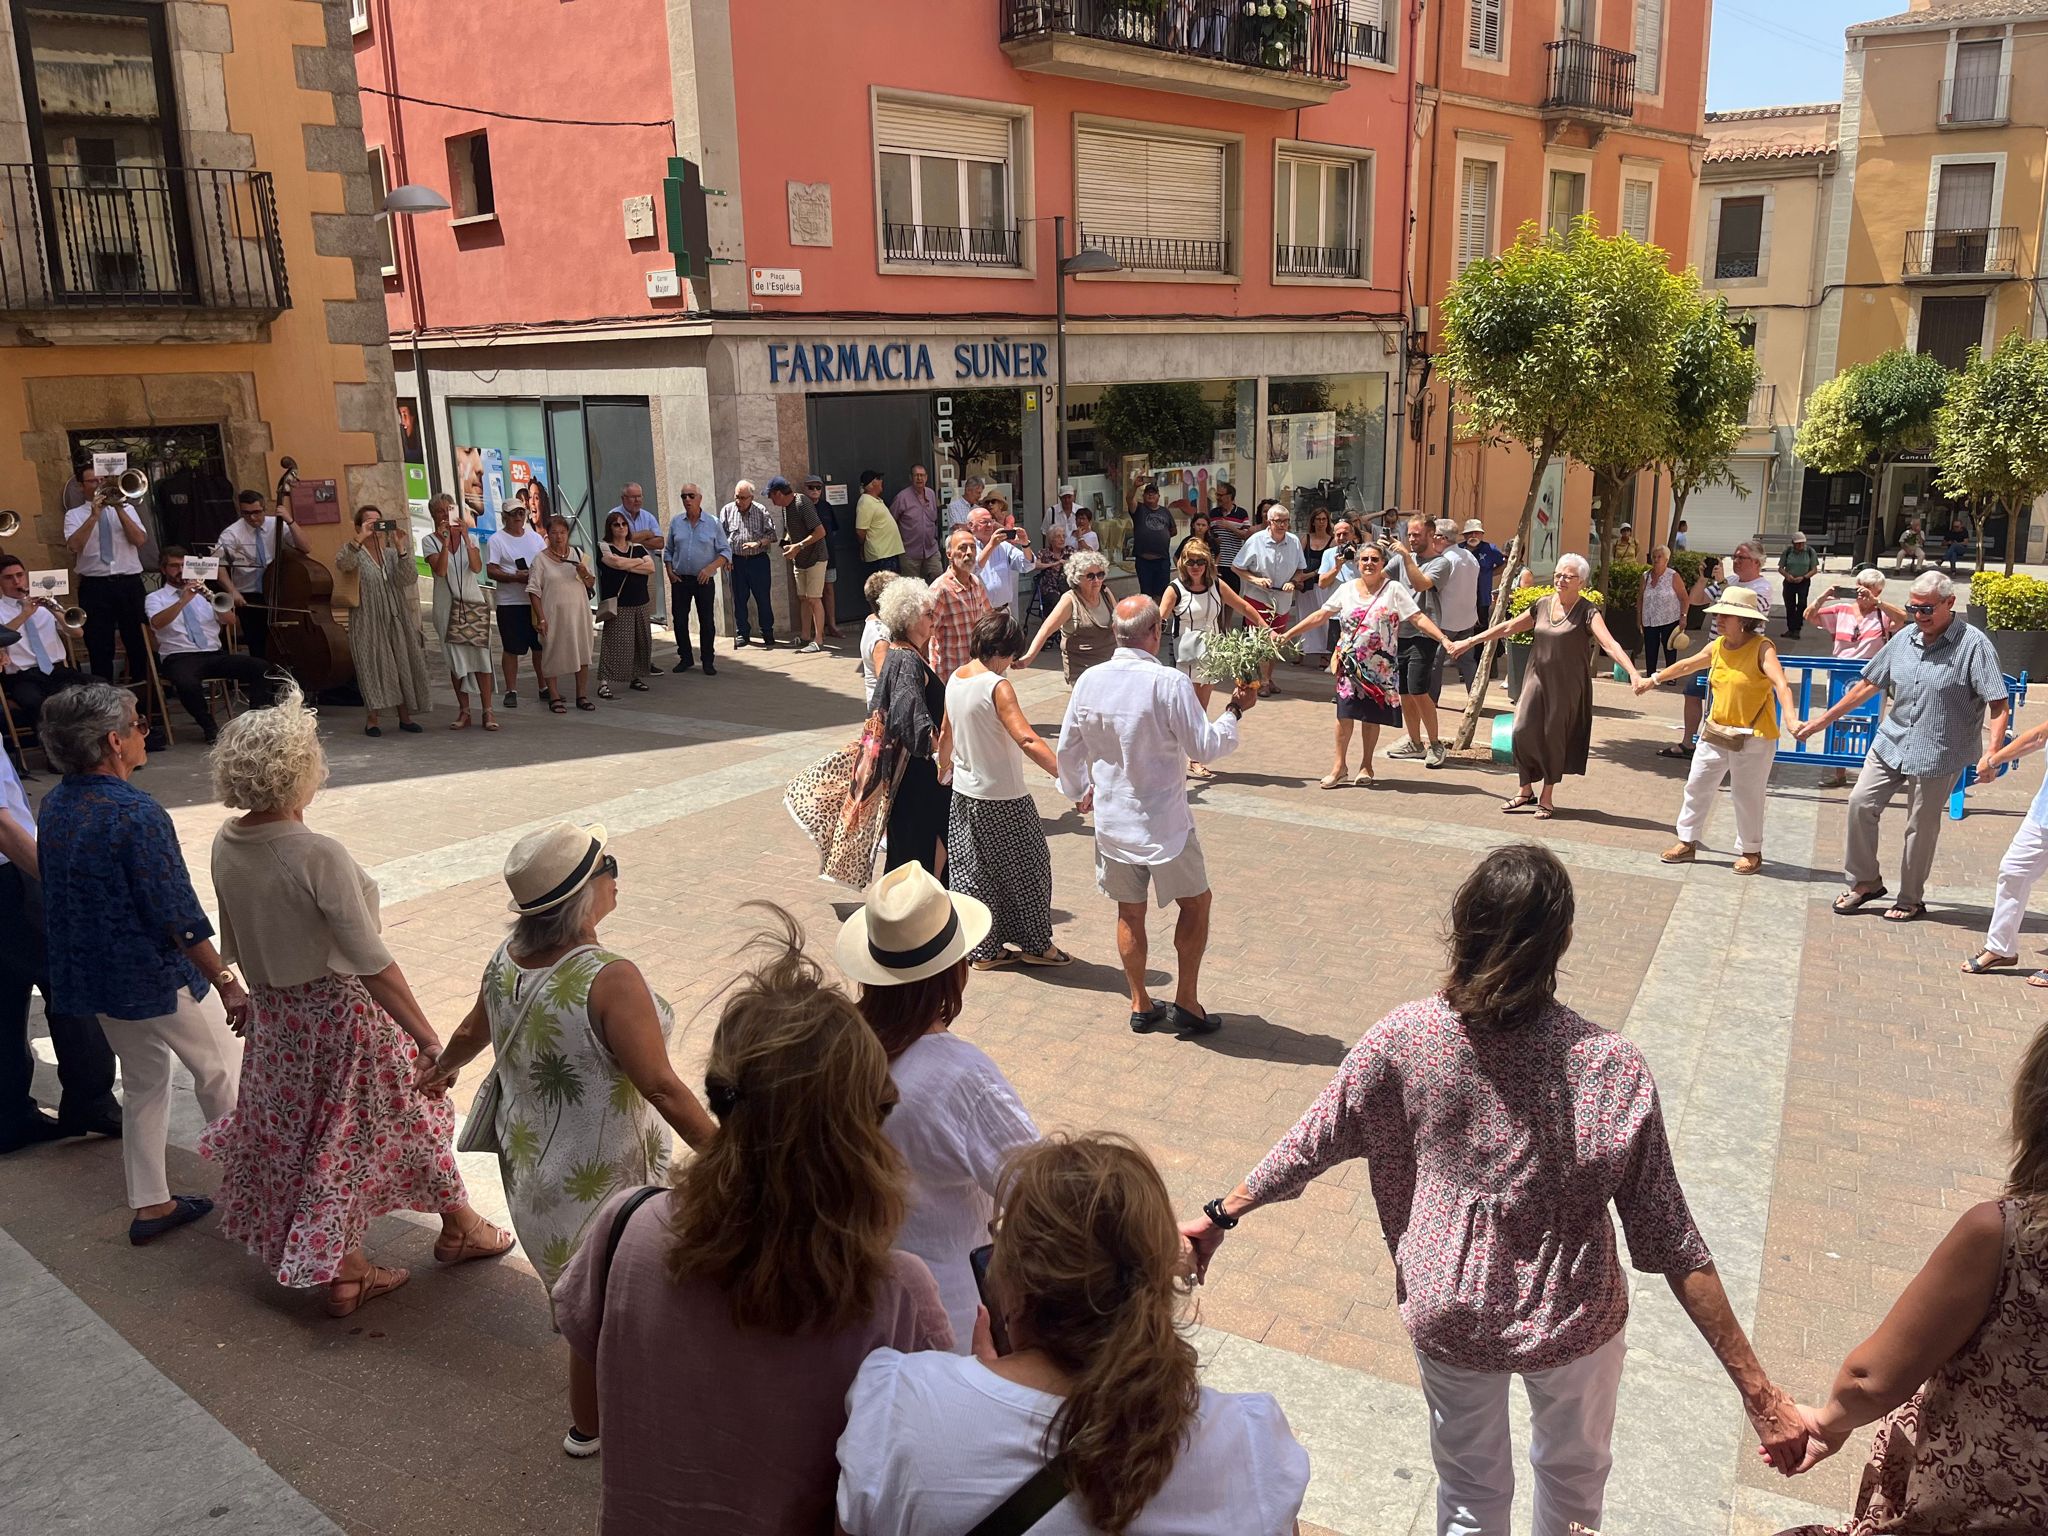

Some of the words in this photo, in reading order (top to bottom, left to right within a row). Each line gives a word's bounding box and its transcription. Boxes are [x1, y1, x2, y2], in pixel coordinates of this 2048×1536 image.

[770, 272, 785, 281] Plaça
[655, 284, 669, 294] Major
[755, 282, 764, 291] de
[766, 281, 801, 293] l'Església
[768, 343, 935, 383] FARMACIA
[954, 336, 1048, 379] SUÑER
[1045, 385, 1053, 403] 9
